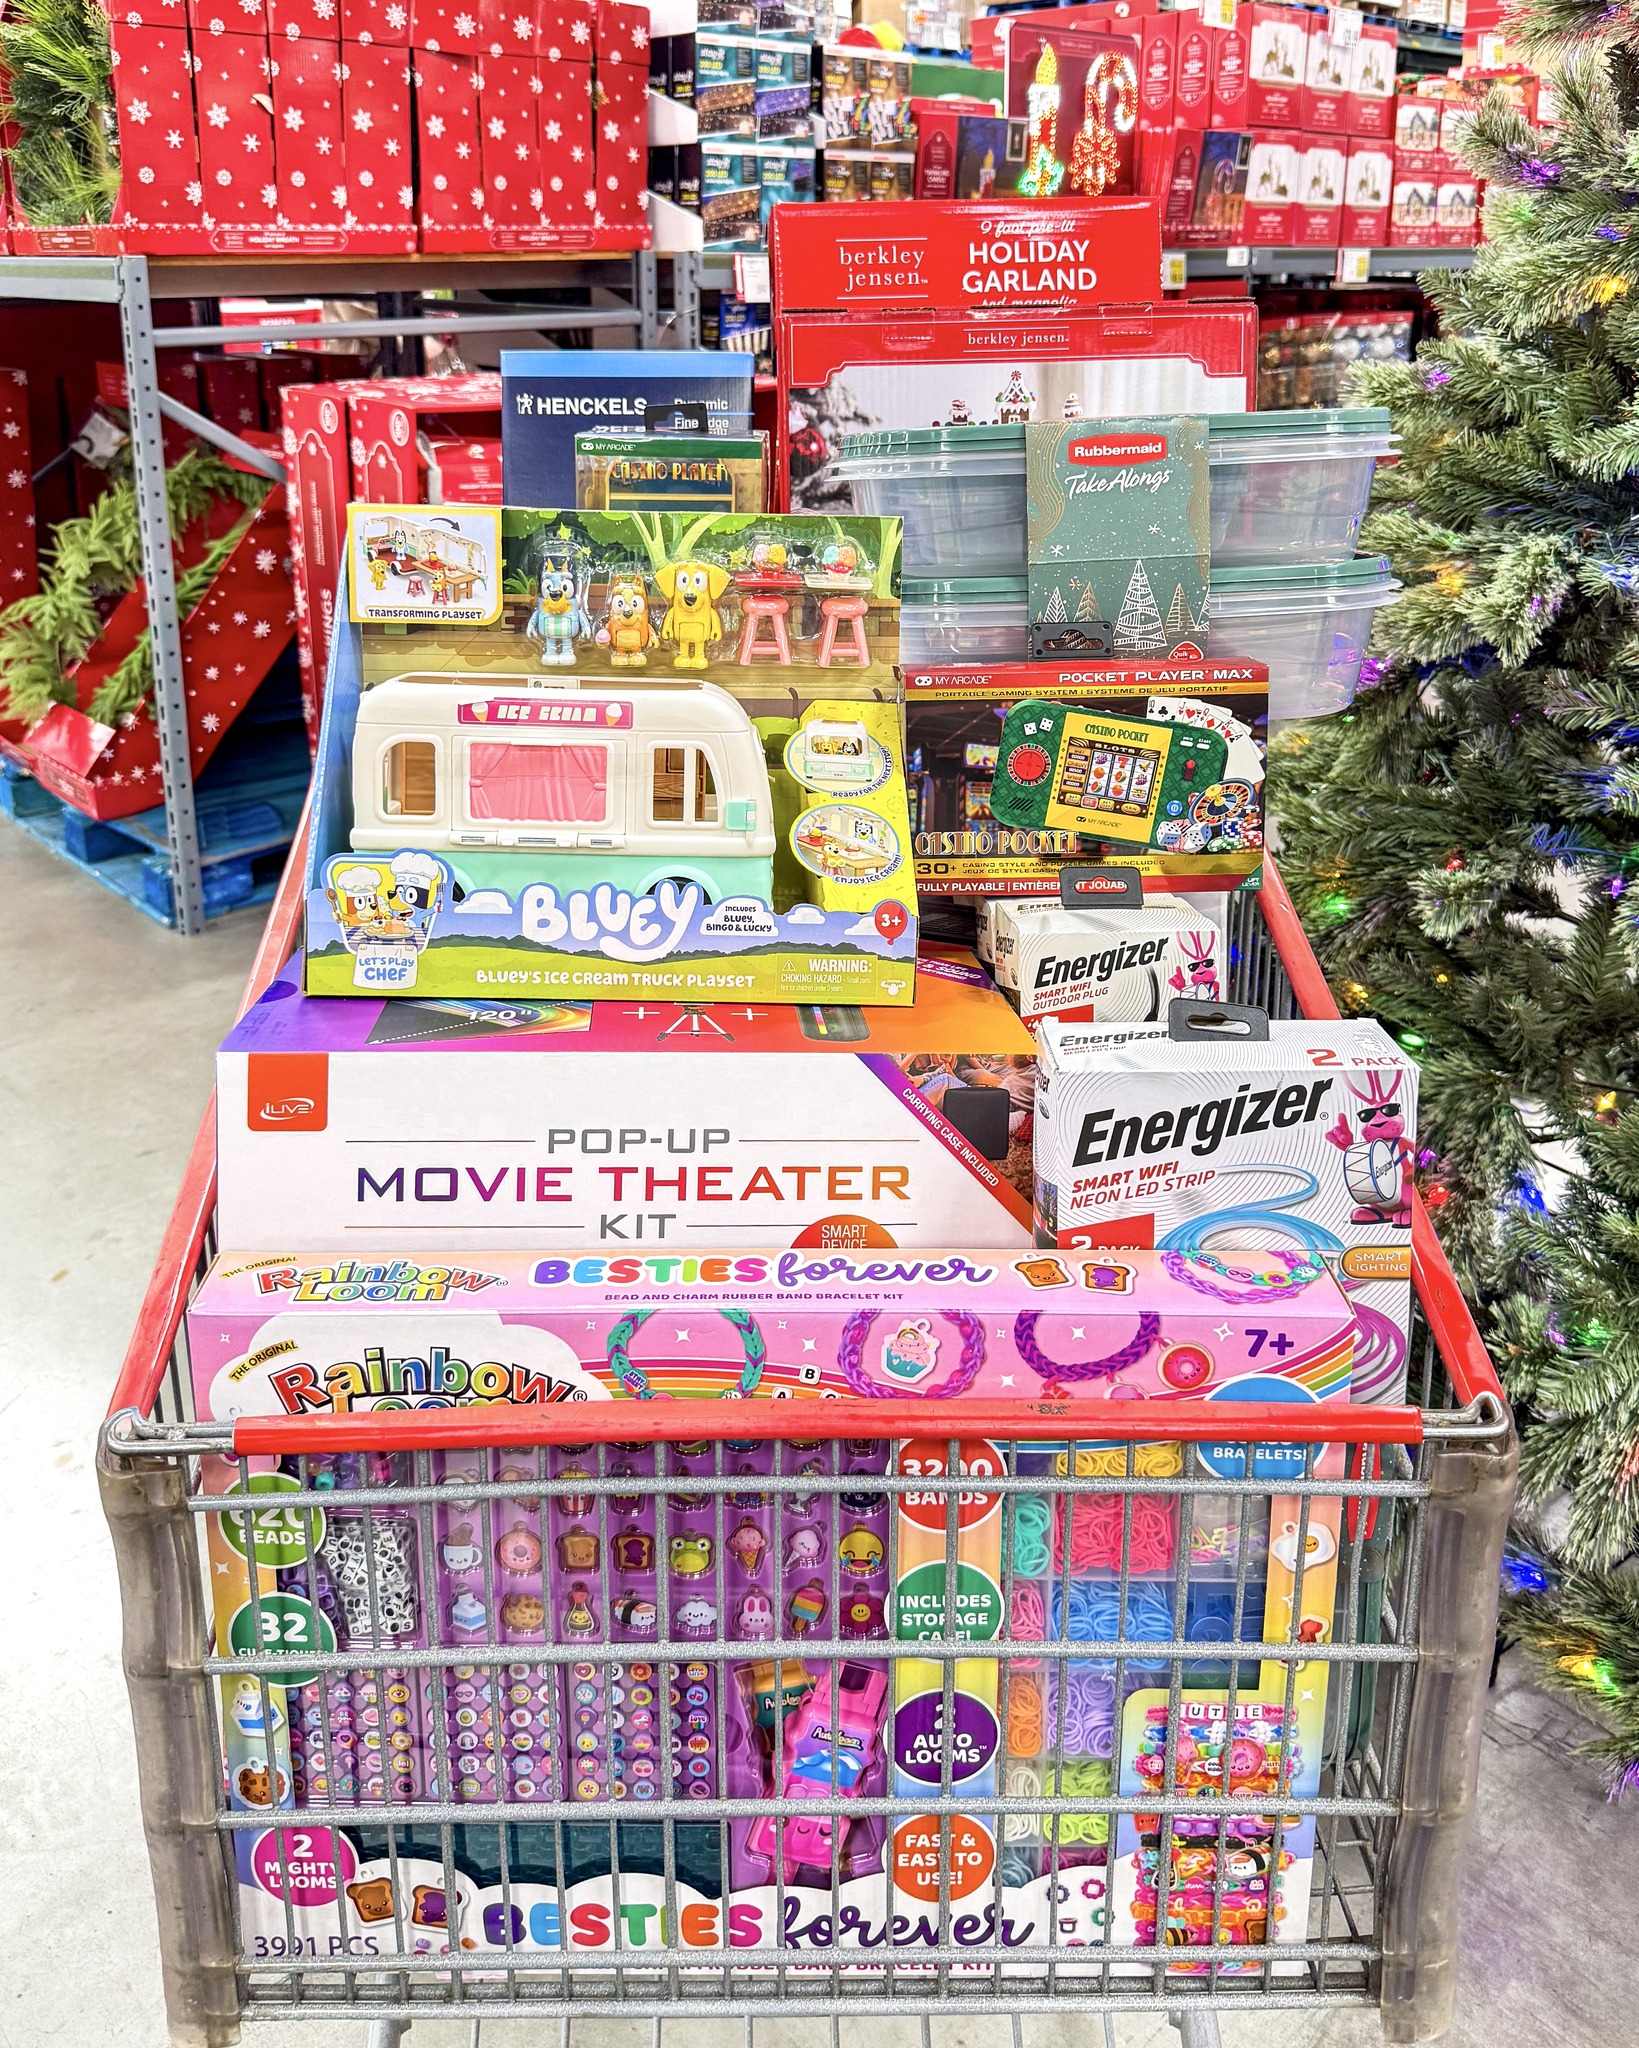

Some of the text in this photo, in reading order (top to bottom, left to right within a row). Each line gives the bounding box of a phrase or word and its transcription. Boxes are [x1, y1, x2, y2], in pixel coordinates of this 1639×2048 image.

[980, 221, 991, 234] 9
[995, 221, 1026, 238] foot
[839, 244, 925, 270] berkley
[969, 239, 1090, 264] HOLIDAY
[844, 268, 921, 292] jensen
[962, 268, 1097, 294] GARLAND
[968, 332, 1065, 347] berkley jensen
[537, 397, 648, 416] HENCKELS
[674, 416, 699, 430] Fine
[1074, 441, 1163, 458] Rubbermaid
[612, 462, 731, 481] CASINO PLAYER
[936, 675, 989, 685] MY ARCADE
[1059, 669, 1254, 684] POCKET PLAYER MAX
[1179, 685, 1228, 693] PORTATIF
[497, 705, 531, 720] ICE
[1084, 723, 1150, 743] CASINO POCKET
[1094, 742, 1136, 755] SLOTS
[832, 746, 893, 798] READY FOR THE NEXT STOP!
[915, 830, 1080, 856] CASINO POCKET
[835, 854, 903, 884] ENJOY ICE CREAM!
[917, 862, 957, 875] 30+
[917, 882, 1005, 892] FULLY PLAYABLE
[725, 905, 757, 913] INCLUDES
[521, 880, 700, 963] BLUEY
[706, 923, 772, 933] BINGO & LUCKY
[724, 914, 754, 925] BLUEY,
[881, 914, 902, 928] 3+
[358, 957, 415, 968] LET'S PLAY
[808, 958, 873, 974] WARNING:
[1034, 936, 1170, 989] Energizer
[364, 966, 408, 982] CHEF
[476, 969, 756, 989] BLUEY'S ICE CREAM TRUCK PLAYSET
[781, 974, 812, 984] CHOKING
[813, 975, 842, 984] HAZARD
[847, 976, 859, 984] Small
[936, 966, 982, 979] SOUND
[1032, 982, 1092, 1002] SMART WIFI
[1032, 987, 1109, 1011] OUTDOOR PLUG
[468, 1009, 532, 1021] 120"
[1059, 1031, 1170, 1047] Energizer
[1307, 1049, 1405, 1067] 2 PACK
[1072, 1077, 1335, 1168] Energizer
[548, 1129, 730, 1154] POP-UP
[901, 1086, 1000, 1187] CARRYING CASE INCLUDED
[357, 1166, 911, 1202] MOVIE THEATER
[1071, 1161, 1179, 1195] SMART WIFI
[1070, 1169, 1216, 1210] NEON LED STRIP
[600, 1214, 677, 1240] KIT
[821, 1225, 869, 1239] SMART
[822, 1239, 868, 1249] DEVICE
[1354, 1252, 1403, 1262] SMART
[221, 1256, 299, 1279] THE ORIGINAL
[257, 1260, 498, 1294] Rainbow
[533, 1255, 992, 1289] BESTIES forever
[1348, 1262, 1408, 1273] LIGHTING
[293, 1281, 449, 1301] Loom
[604, 1294, 640, 1302] BEAD
[721, 1293, 773, 1301] RUBBER
[776, 1293, 813, 1301] BAND
[815, 1293, 878, 1301] BRACELET
[1244, 1329, 1295, 1358] 7+
[230, 1341, 298, 1381] THE ORIGINAL
[268, 1346, 577, 1416] Rainbow
[804, 1368, 815, 1379] B
[259, 1612, 308, 1643] 32
[292, 1835, 314, 1858] 2
[961, 1834, 976, 1847] &
[955, 1853, 983, 1866] TO
[784, 1896, 1035, 1948] forever
[328, 1936, 378, 1956] PCS
